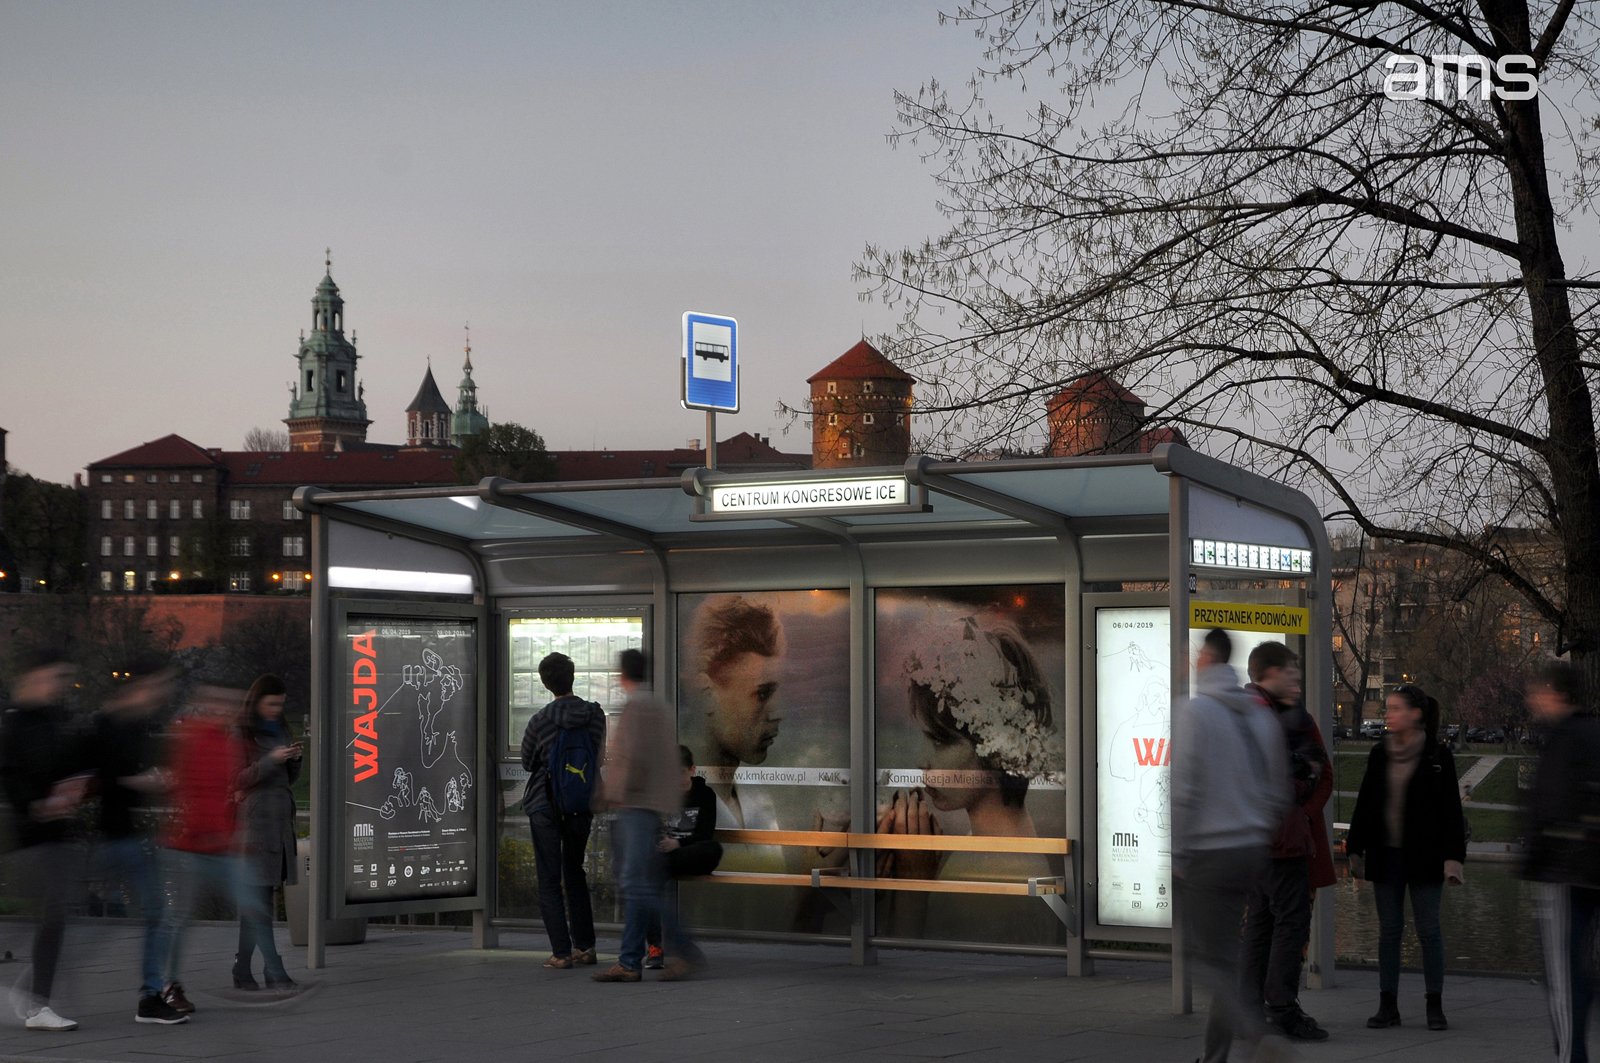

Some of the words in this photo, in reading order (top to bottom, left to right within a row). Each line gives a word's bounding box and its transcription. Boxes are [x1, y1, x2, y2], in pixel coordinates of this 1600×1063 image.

[721, 491, 780, 507] CENTRUM
[783, 486, 872, 504] KONGRESOWE
[876, 485, 896, 500] ICE
[1194, 608, 1253, 625] PRZYSTANEK
[1255, 610, 1303, 627] PODWÓJNY
[353, 629, 379, 783] WAJDA
[818, 771, 841, 783] KMK
[887, 772, 950, 786] Komunikacja
[953, 773, 993, 786] Miejska
